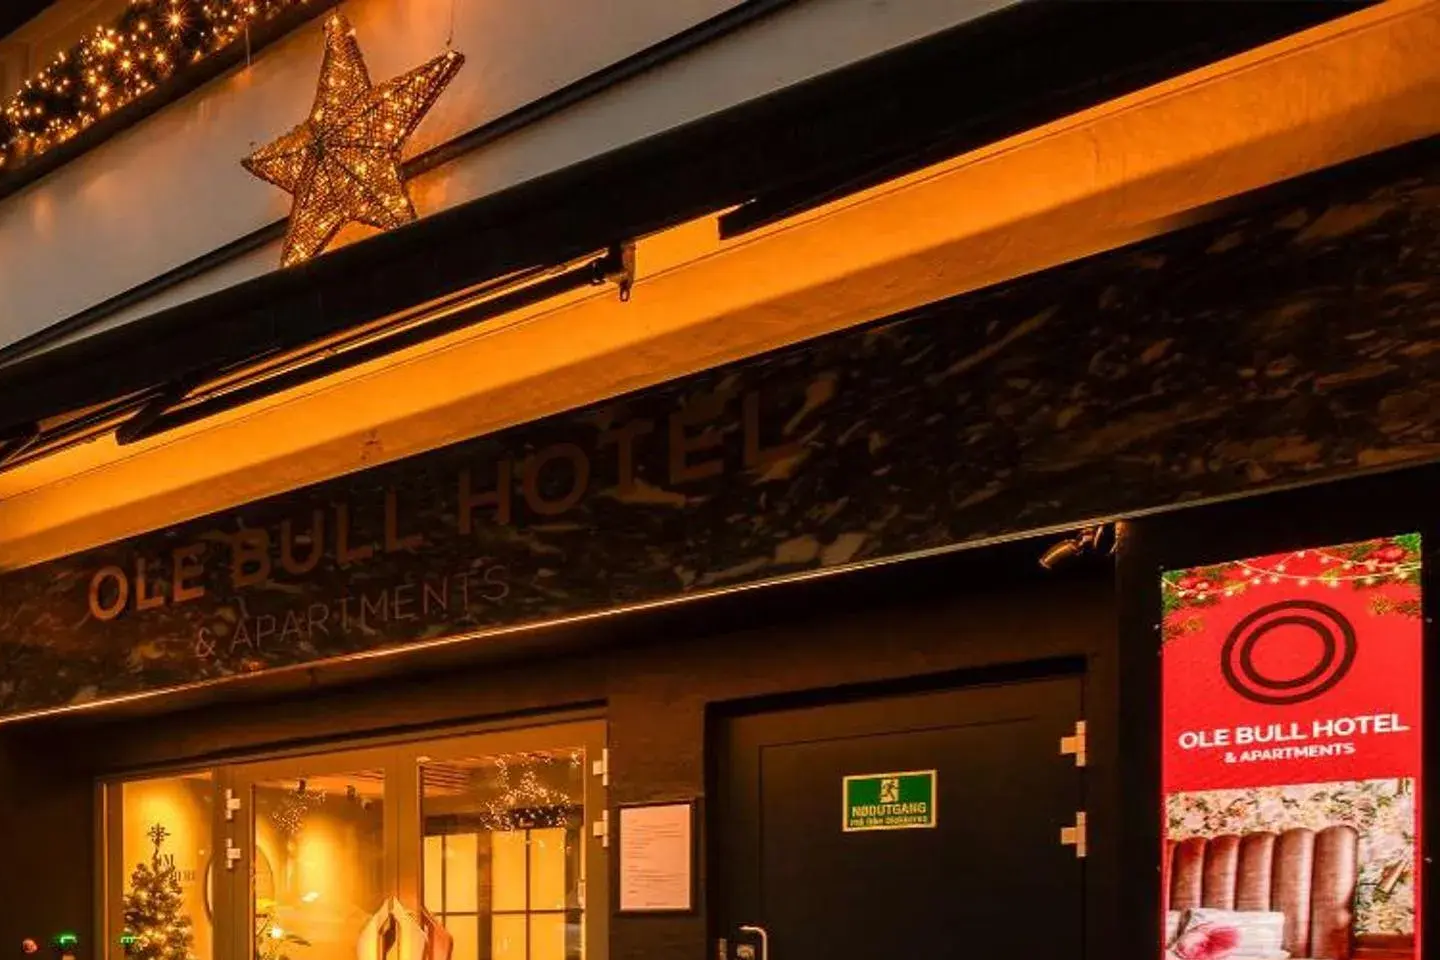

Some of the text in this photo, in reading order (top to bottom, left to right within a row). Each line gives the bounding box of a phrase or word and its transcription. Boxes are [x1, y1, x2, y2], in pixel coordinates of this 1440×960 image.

[88, 390, 804, 622] OLE BULL HOTEL
[195, 565, 511, 658] & APARTMENTS
[1178, 713, 1409, 750] OLE BULL HOTEL
[1224, 742, 1356, 764] & APARTMENTS
